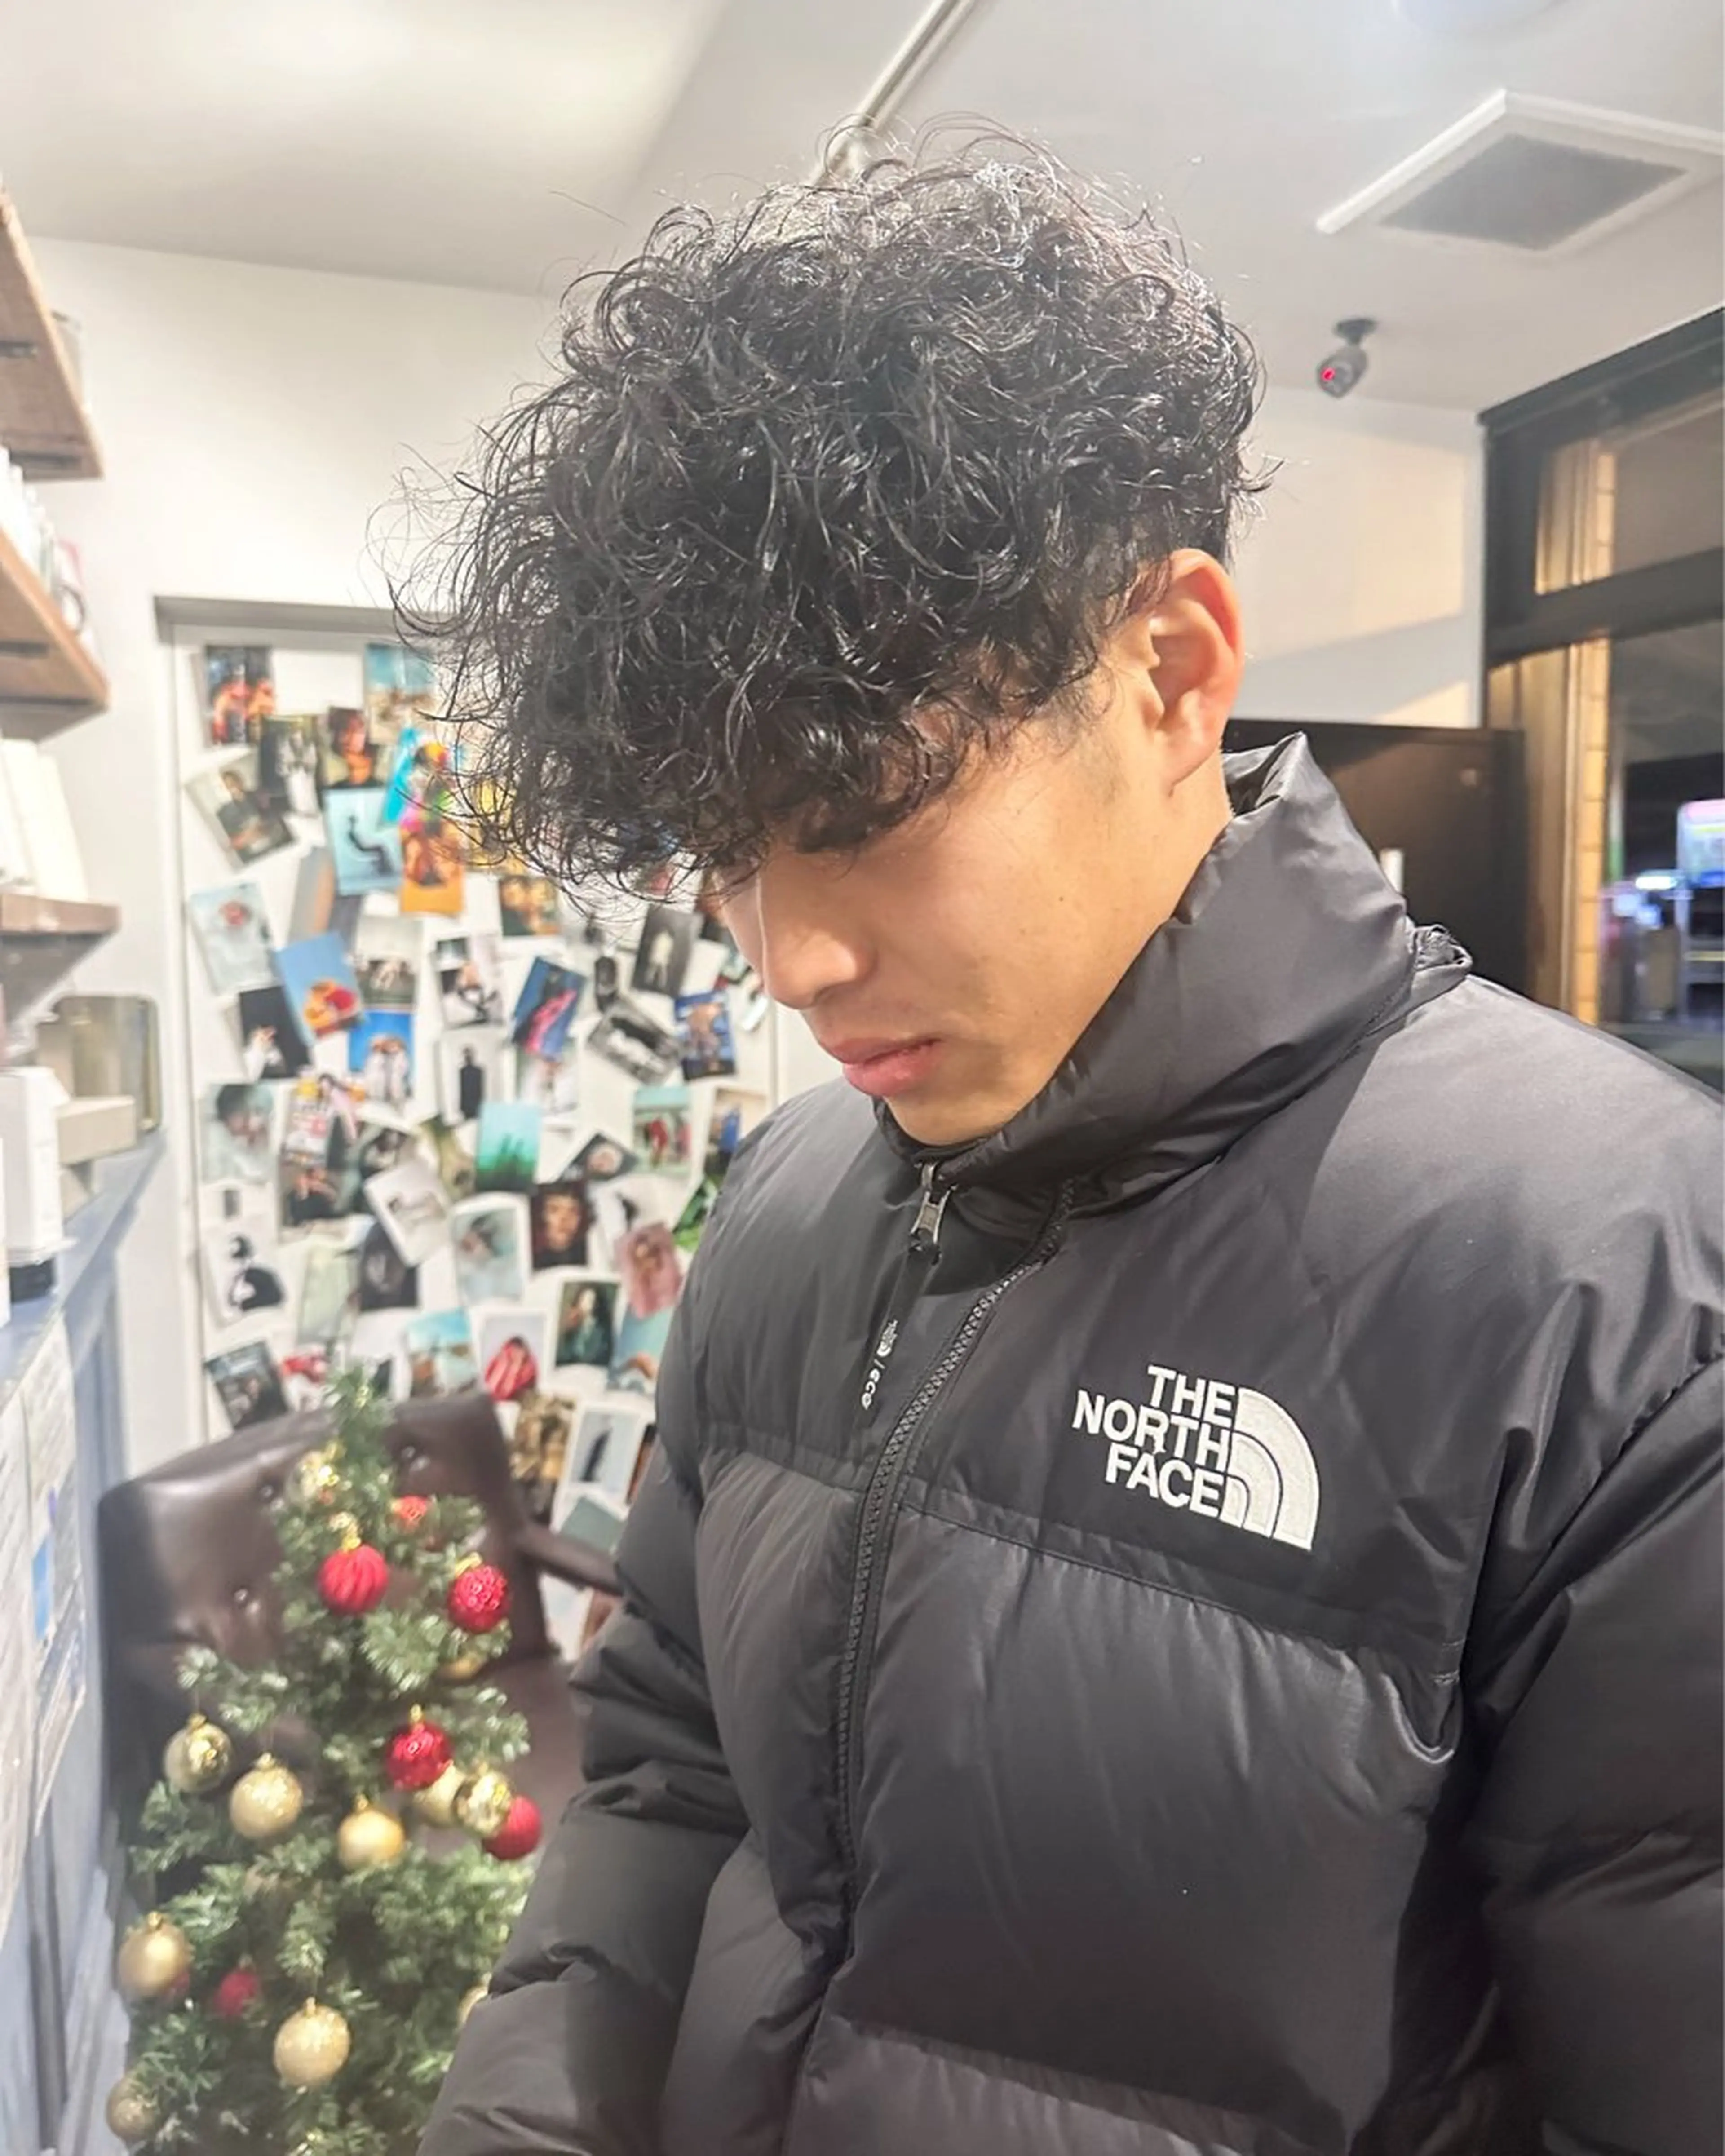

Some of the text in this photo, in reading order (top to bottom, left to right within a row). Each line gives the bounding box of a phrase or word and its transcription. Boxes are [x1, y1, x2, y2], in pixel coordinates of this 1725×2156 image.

[1072, 1389, 1231, 1472] NORTH
[1147, 1364, 1236, 1428] THE
[1105, 1442, 1225, 1518] FACE
